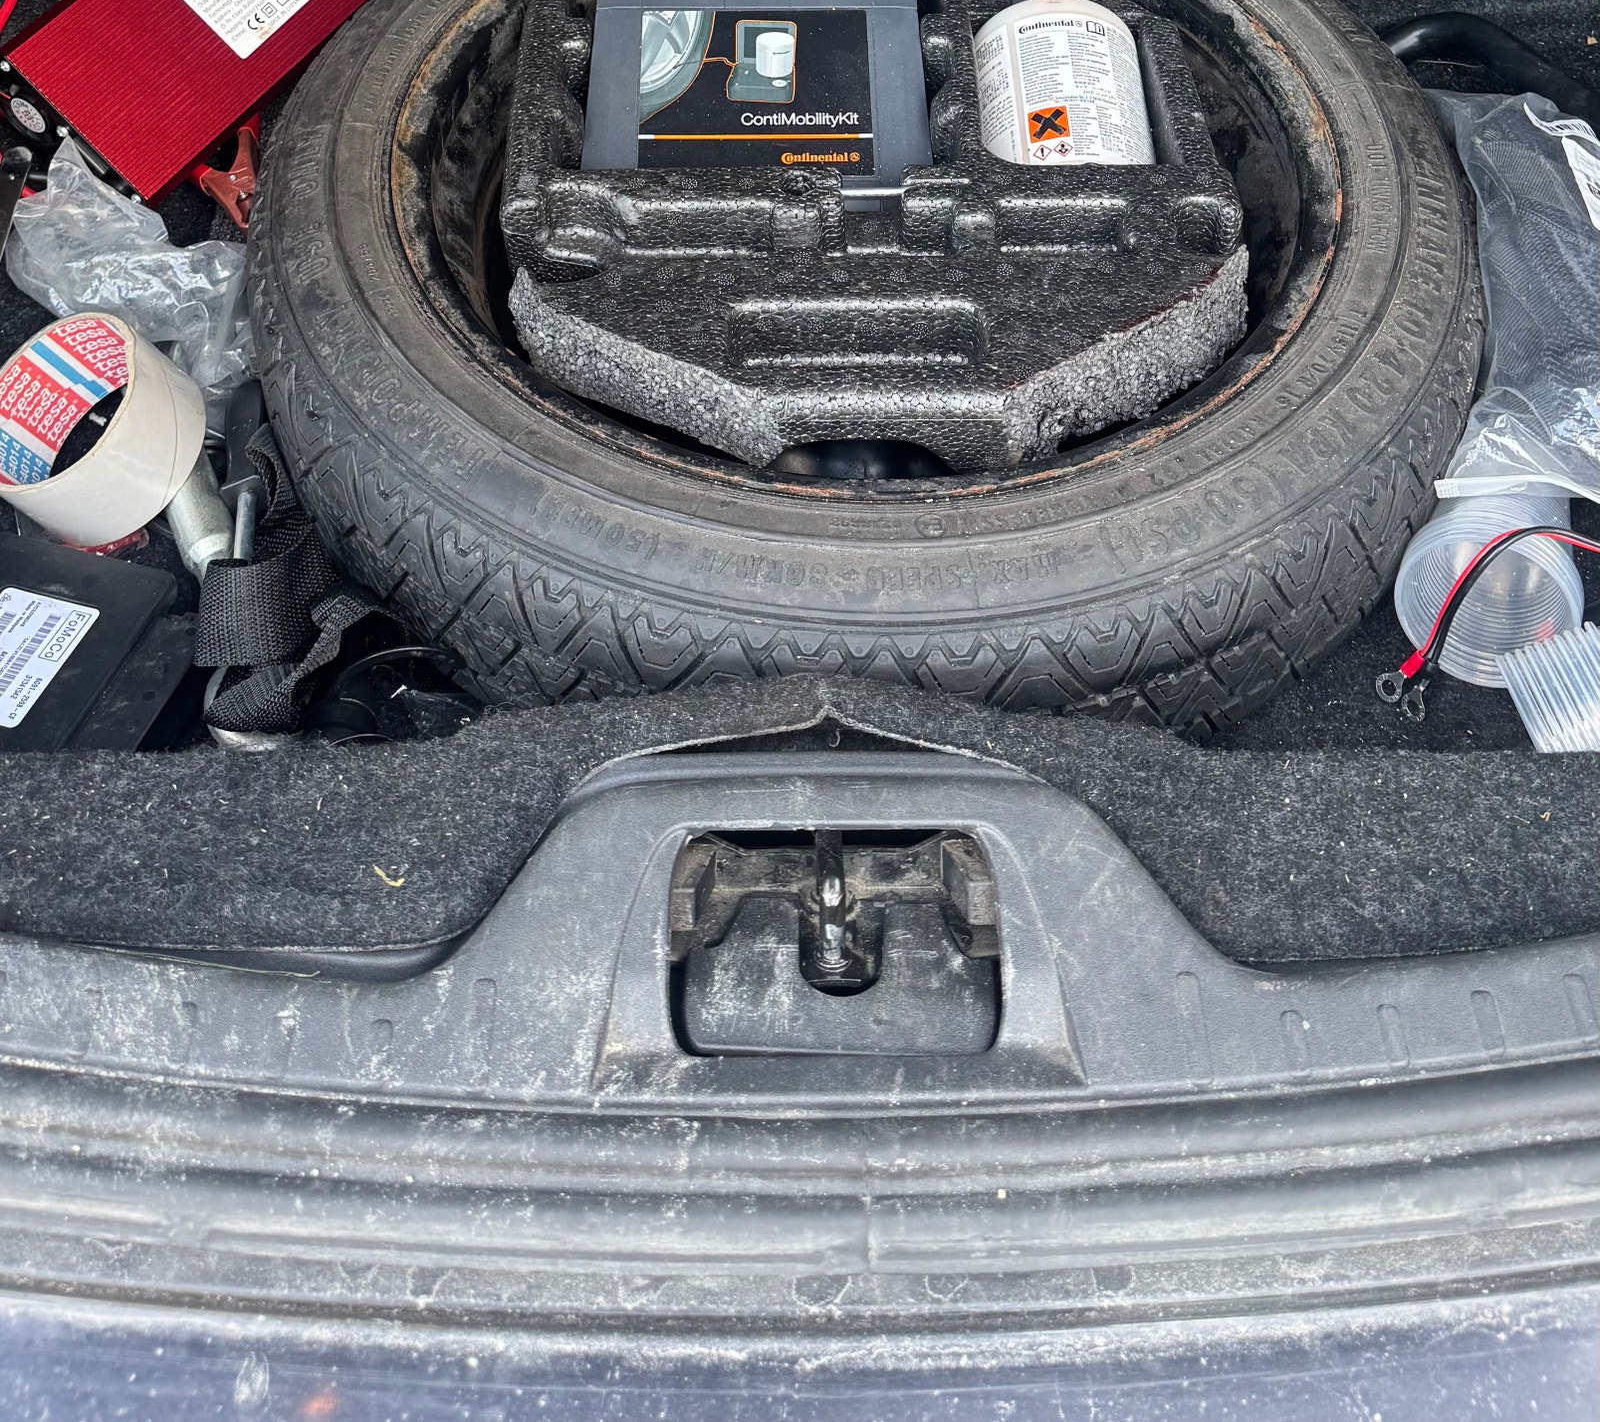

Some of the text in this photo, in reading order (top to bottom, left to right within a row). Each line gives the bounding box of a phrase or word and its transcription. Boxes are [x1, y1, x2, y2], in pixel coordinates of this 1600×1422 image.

[1018, 20, 1074, 34] Continental
[740, 112, 860, 128] ContiMobilityKit
[780, 152, 849, 164] Continental
[52, 320, 97, 337] tesa
[63, 328, 108, 346] tesa
[73, 336, 118, 354] tesa
[1, 372, 31, 411] tesa
[10, 380, 41, 417] tesa
[37, 397, 68, 434] tesa
[47, 405, 77, 442] tesa
[8, 441, 21, 478] 64014
[44, 614, 85, 658] FoMoCo
